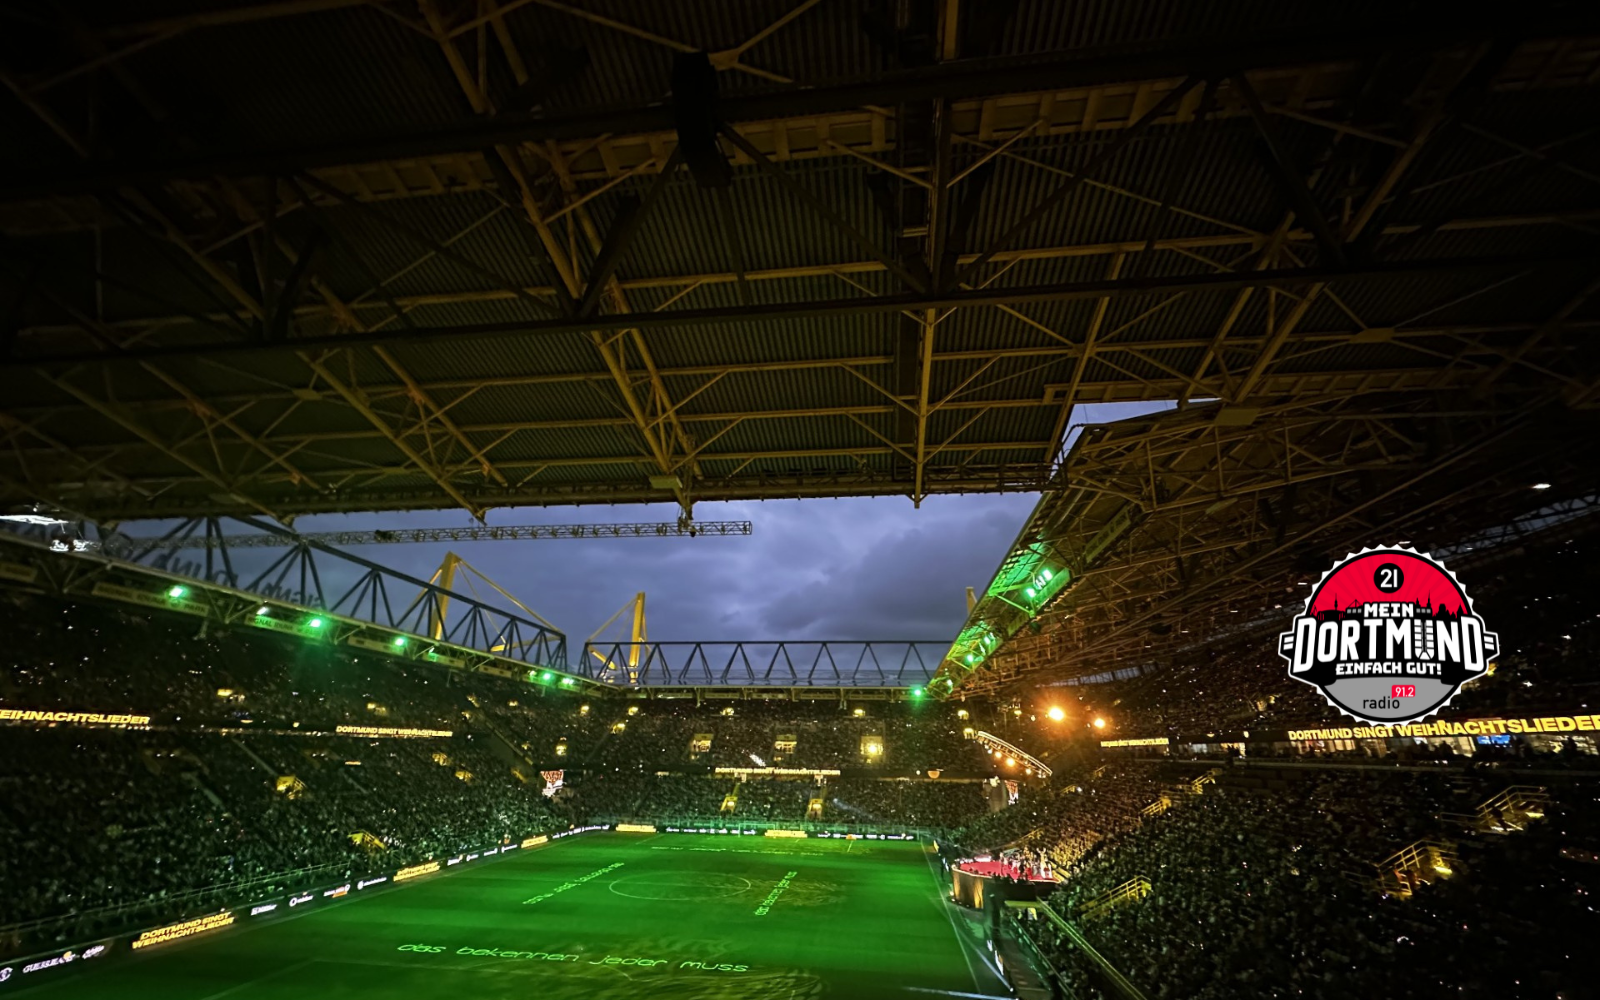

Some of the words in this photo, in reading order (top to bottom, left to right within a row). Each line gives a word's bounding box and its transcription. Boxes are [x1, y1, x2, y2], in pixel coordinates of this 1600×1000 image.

[0, 708, 151, 725] EIHNACHTSLIEDER
[335, 725, 378, 734] DORTMUND
[1288, 727, 1353, 741] DORTMUND
[1353, 725, 1395, 739] SINGT
[132, 917, 235, 949] WEIHNACHTSLIEDER
[140, 919, 202, 940] DORTMUND
[202, 912, 232, 925] SINGT
[397, 943, 446, 954] das
[456, 946, 579, 962] bekennen
[589, 955, 668, 967] jeder
[679, 961, 751, 973] muss
